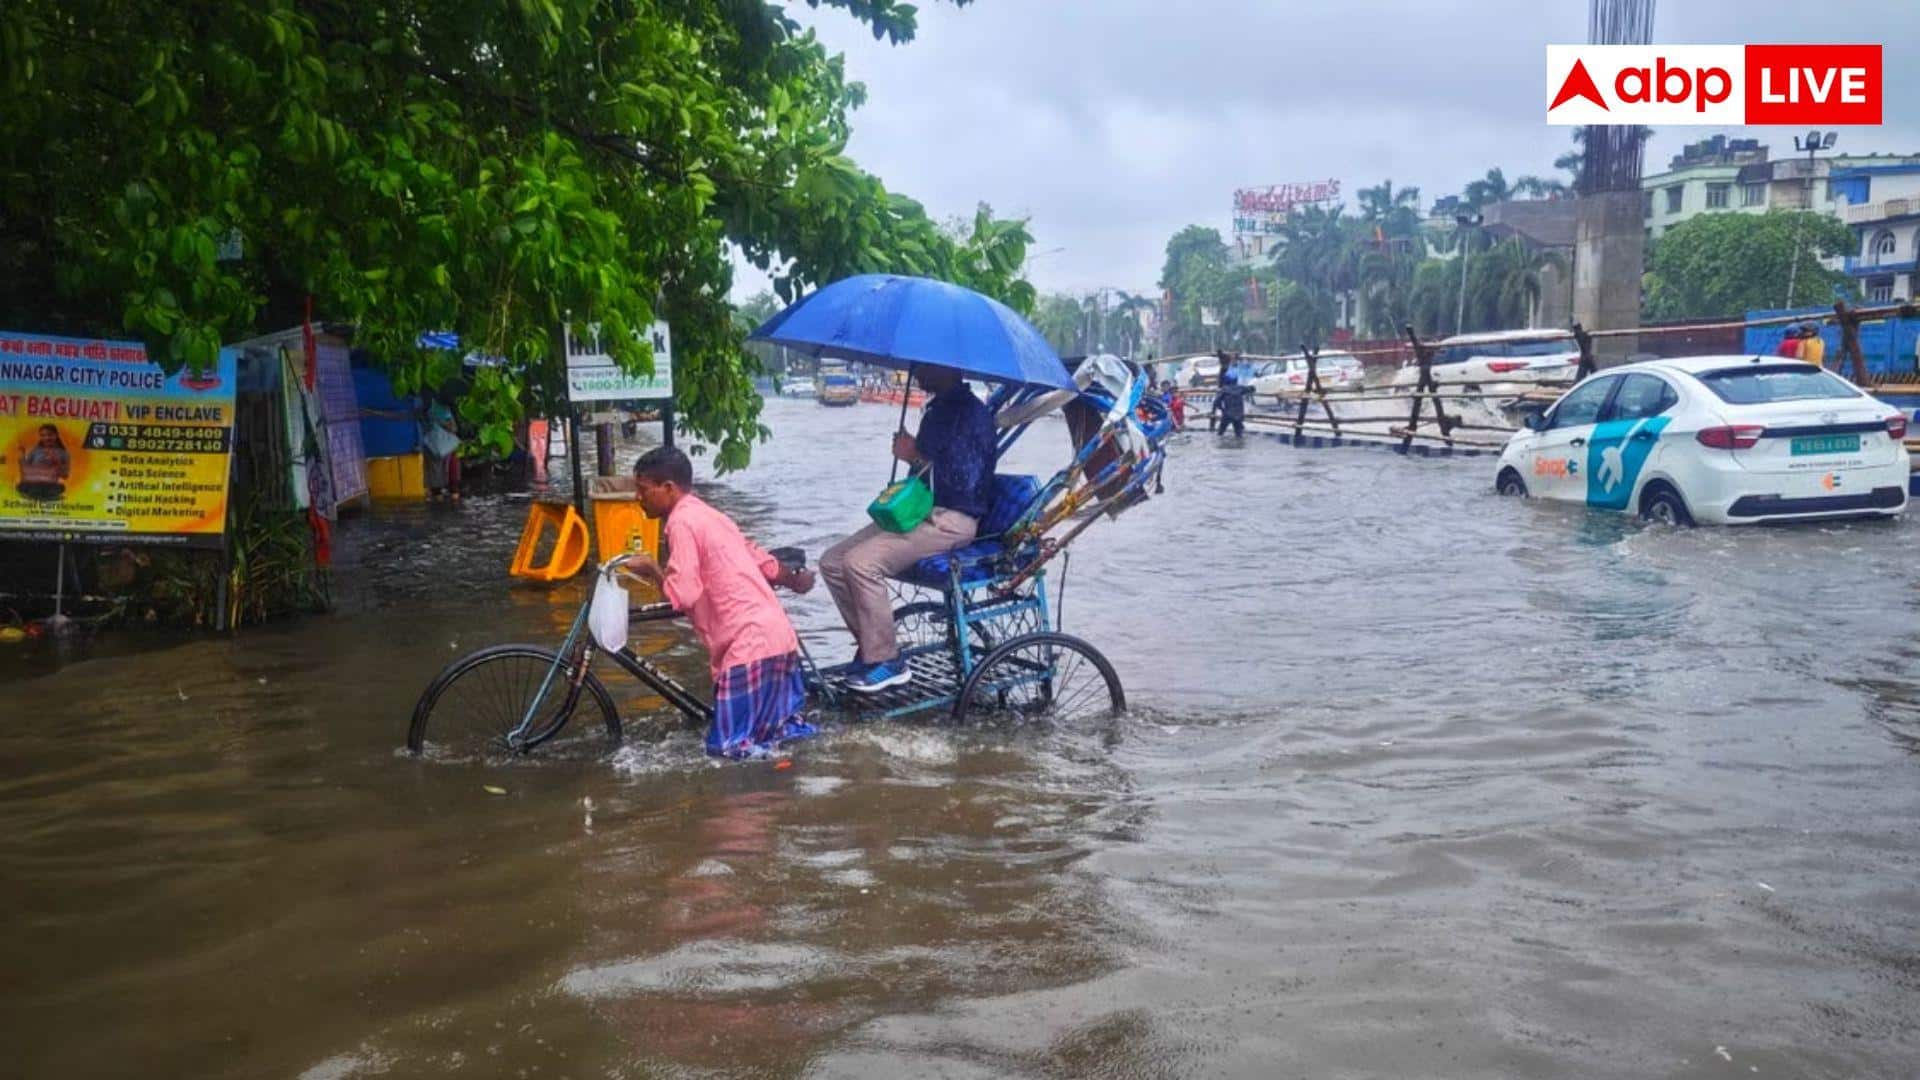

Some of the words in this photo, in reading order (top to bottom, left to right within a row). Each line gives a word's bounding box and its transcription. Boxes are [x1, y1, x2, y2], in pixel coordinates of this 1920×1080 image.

[69, 366, 105, 385] CITY
[110, 370, 164, 389] POLICE
[28, 395, 120, 419] BAGUIATI
[126, 404, 151, 419] VIP
[155, 406, 222, 421] ENCLAVE
[108, 425, 139, 437] 033
[120, 454, 145, 465] Data
[147, 456, 194, 467] Analytics
[119, 467, 145, 478] Data
[145, 468, 187, 479] Science
[161, 482, 223, 494] Intelligence
[117, 493, 153, 503] Ethical
[155, 495, 196, 506] Hacking
[115, 506, 151, 518] Digital
[152, 507, 206, 519] Marketing
